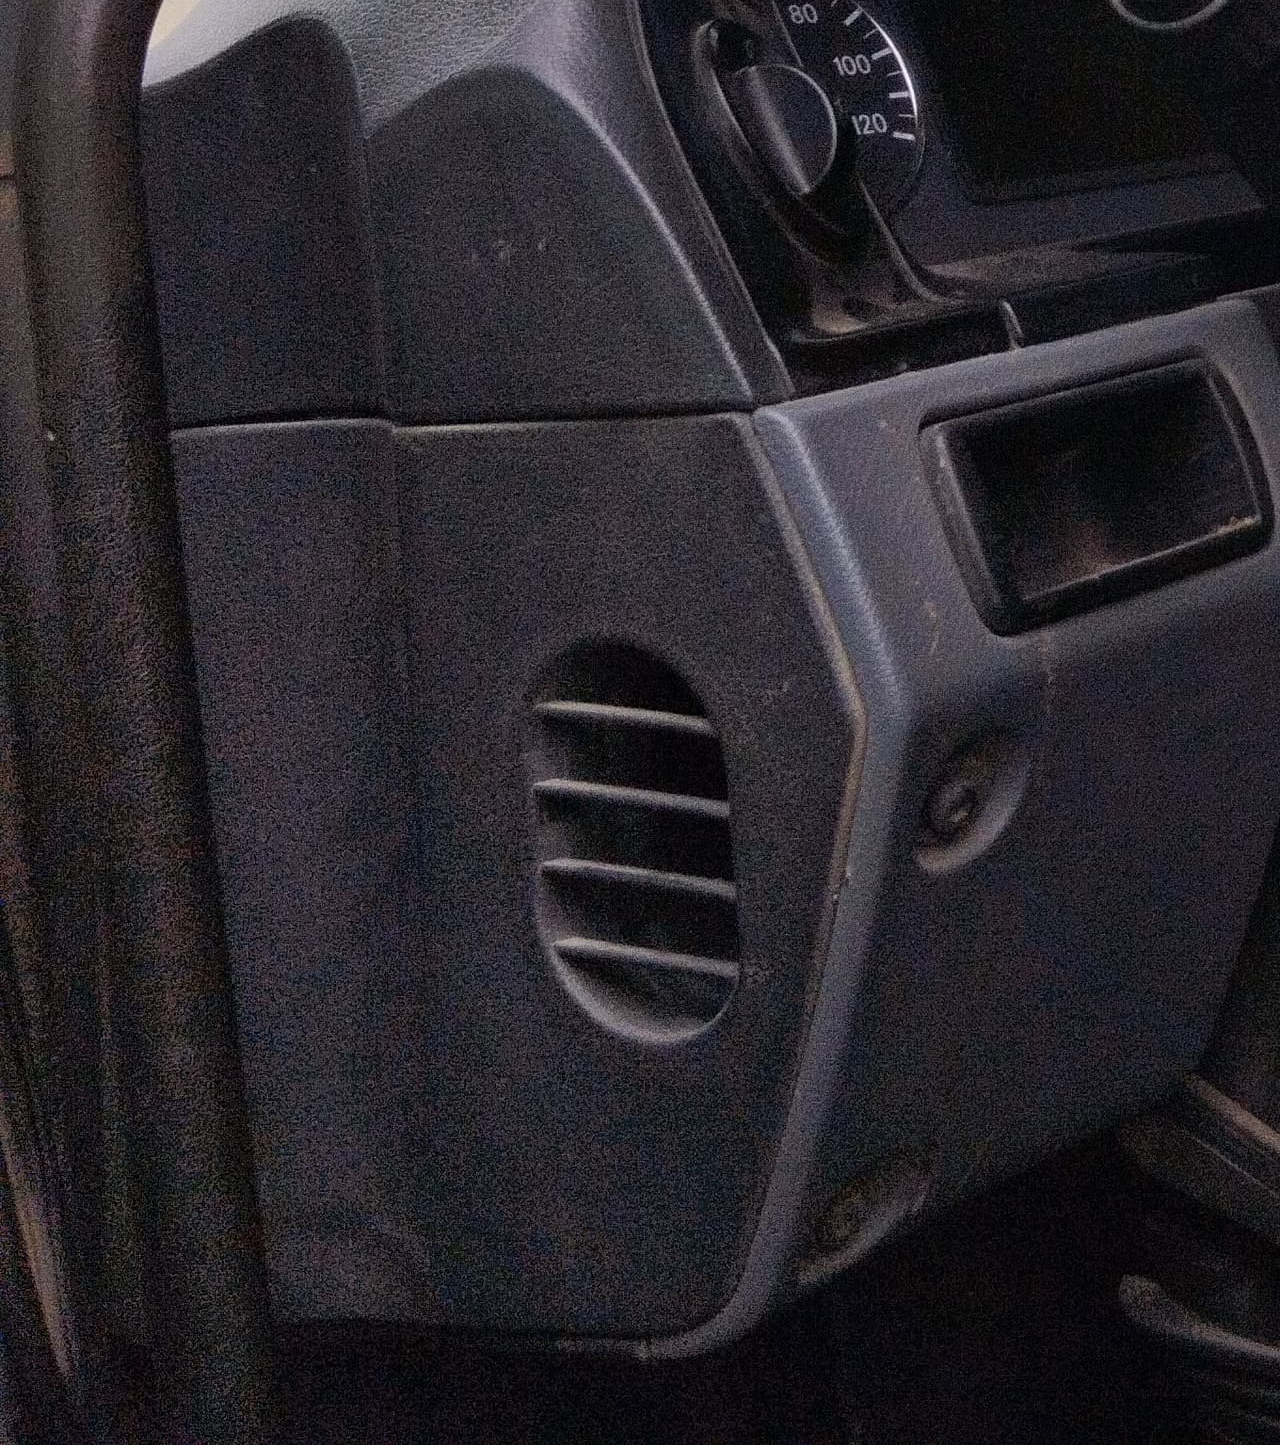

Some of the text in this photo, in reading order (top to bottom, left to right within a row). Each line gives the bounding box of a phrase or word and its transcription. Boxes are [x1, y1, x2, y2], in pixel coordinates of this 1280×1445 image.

[788, 3, 818, 24] 80
[832, 54, 871, 76] 100
[851, 113, 887, 135] 120
